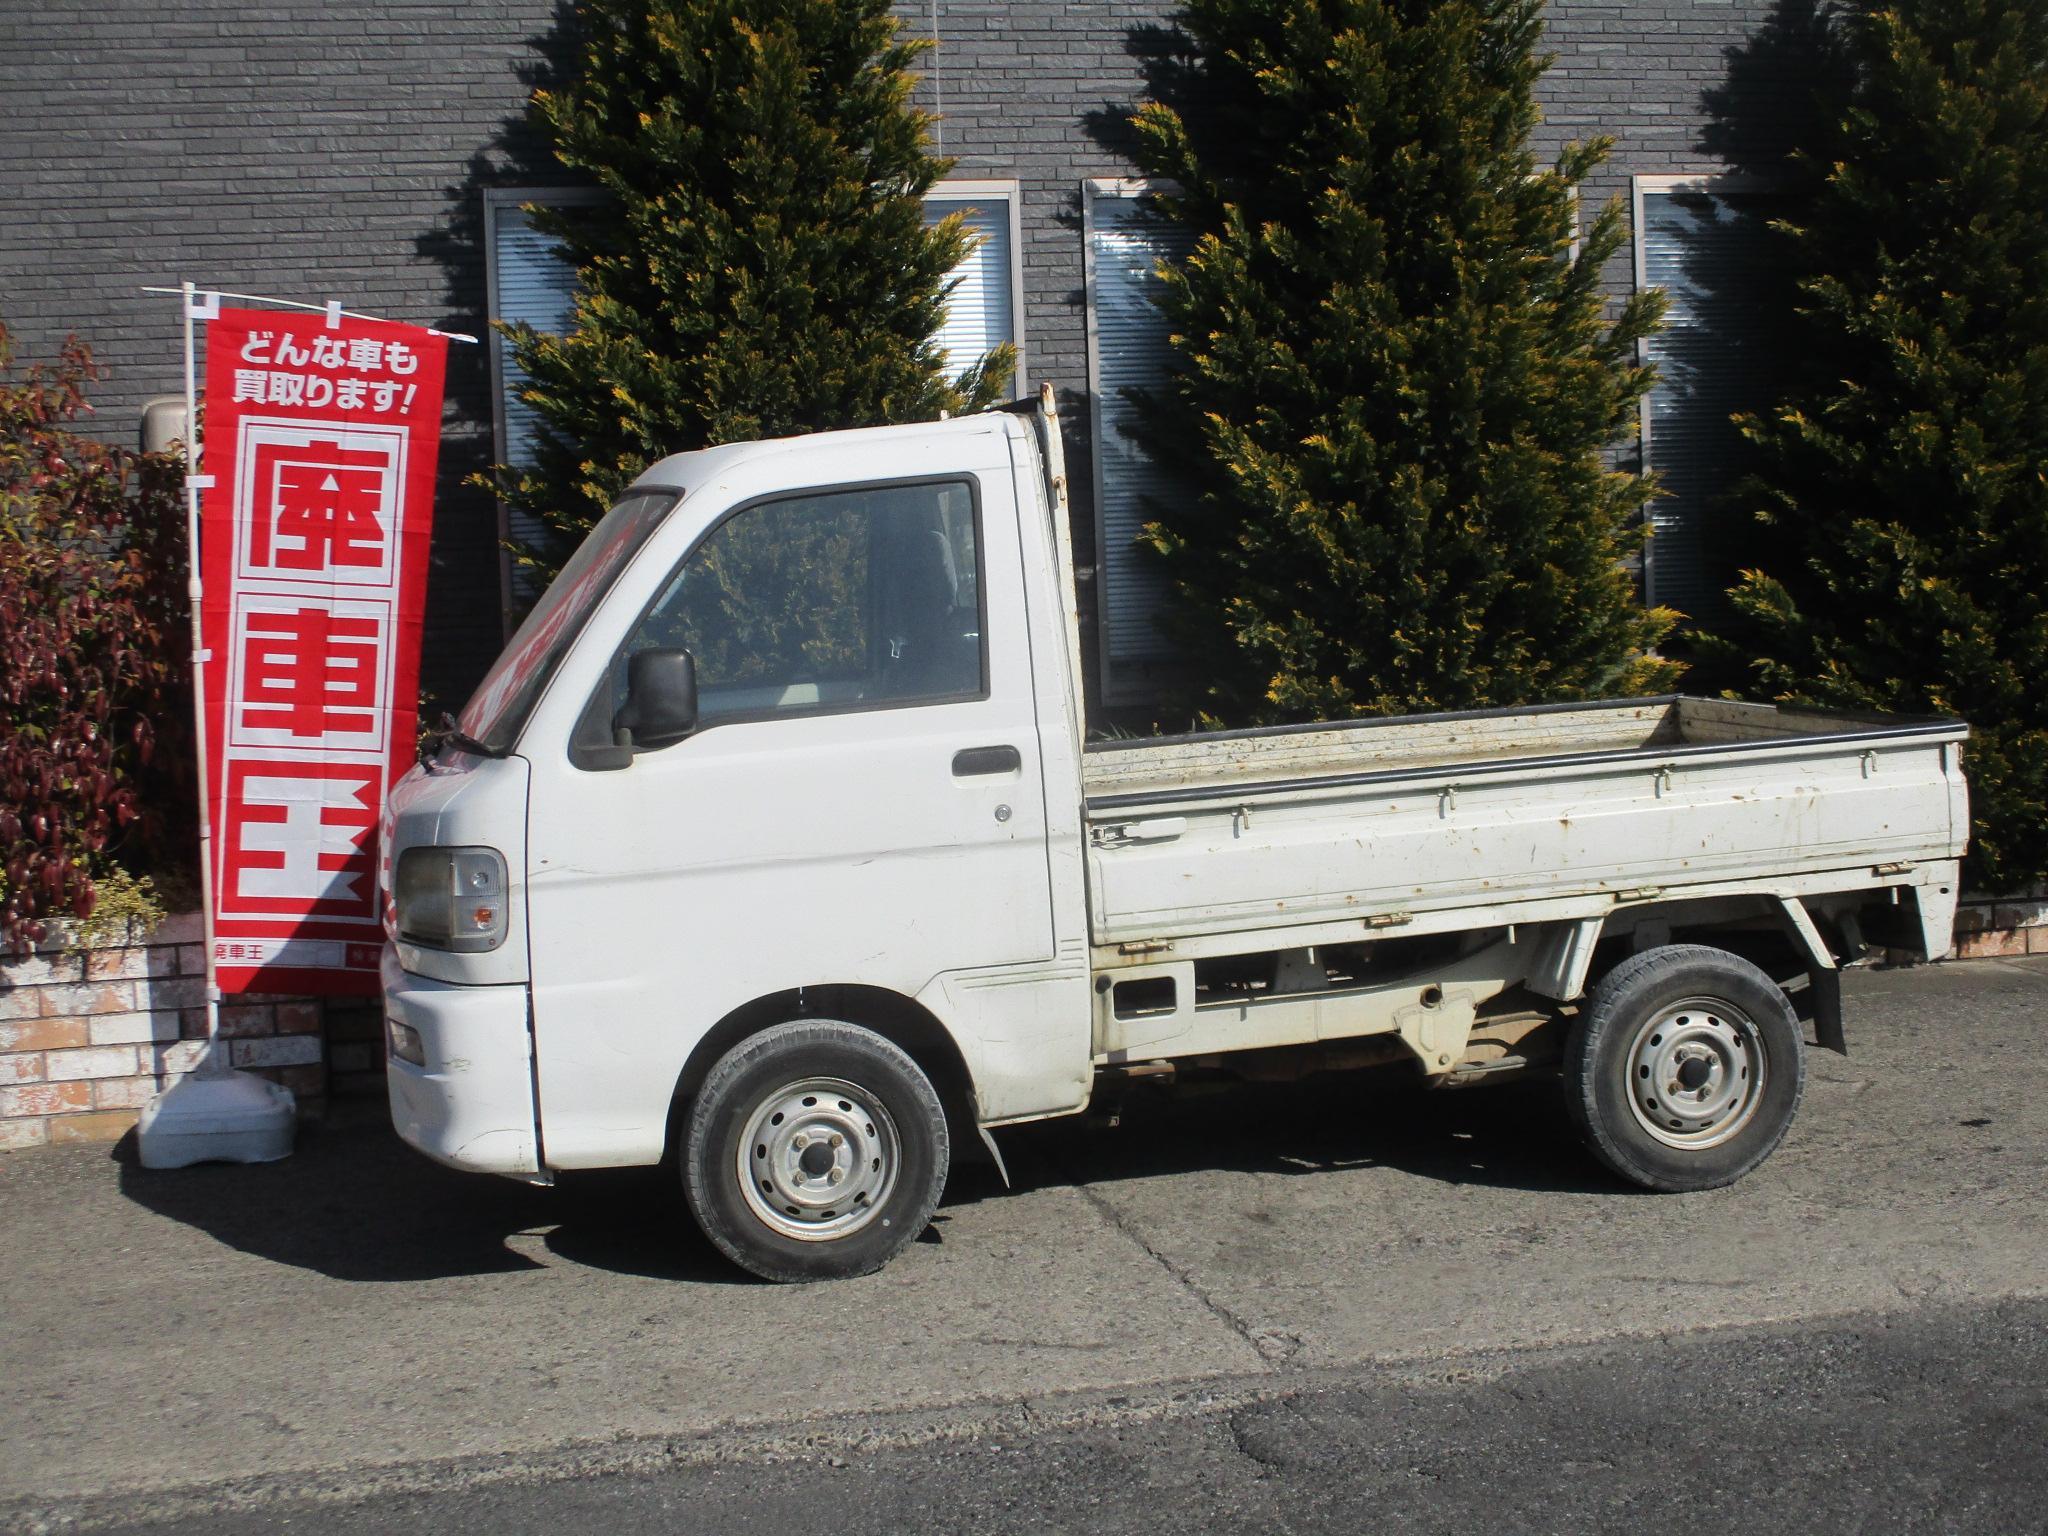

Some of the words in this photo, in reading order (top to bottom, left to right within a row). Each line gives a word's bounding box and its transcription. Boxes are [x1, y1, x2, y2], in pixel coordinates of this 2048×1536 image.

[240, 330, 418, 374] どんな車も
[237, 440, 390, 901] 廃車王
